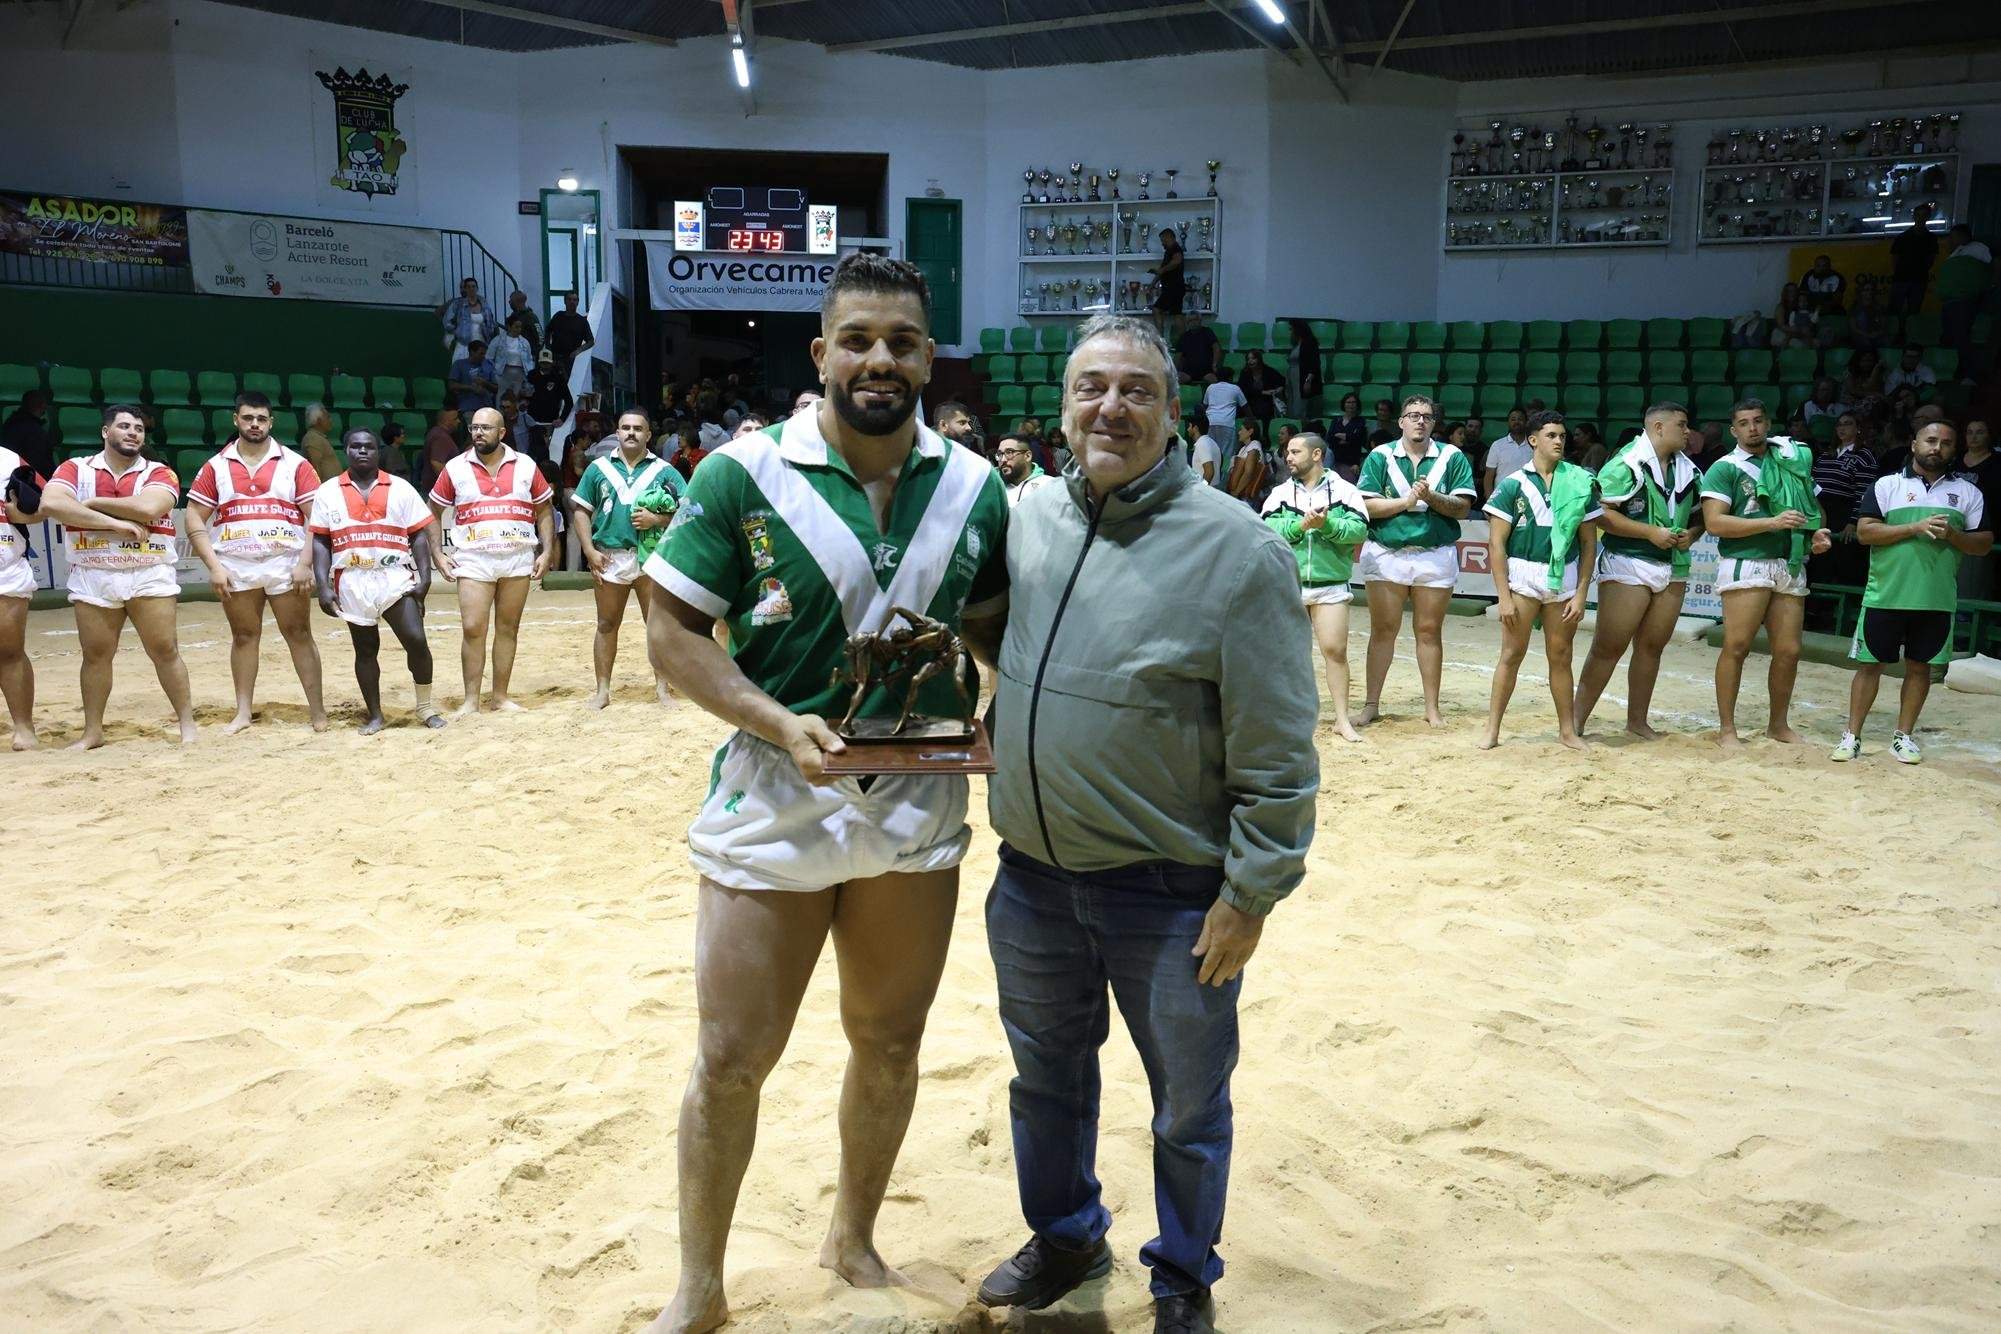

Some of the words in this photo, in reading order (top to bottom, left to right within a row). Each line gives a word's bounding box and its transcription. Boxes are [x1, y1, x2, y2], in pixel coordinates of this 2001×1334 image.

[354, 171, 383, 182] TAO
[26, 197, 138, 227] ASADOR
[285, 223, 334, 237] Barceló
[287, 238, 350, 252] Lanzarote
[288, 251, 326, 264] Active
[330, 253, 368, 267] Resort
[382, 271, 394, 280] BE
[393, 264, 427, 274] ACTIVE
[668, 255, 835, 284] Orvecame
[215, 274, 246, 289] CHAMPS
[668, 284, 724, 297] Organización
[726, 285, 767, 295] Vehículos
[769, 286, 803, 296] Cabrera
[805, 287, 825, 296] Med
[1690, 549, 1719, 562] Priv
[1695, 584, 1712, 595] 88
[1685, 597, 1723, 608] egur.c
